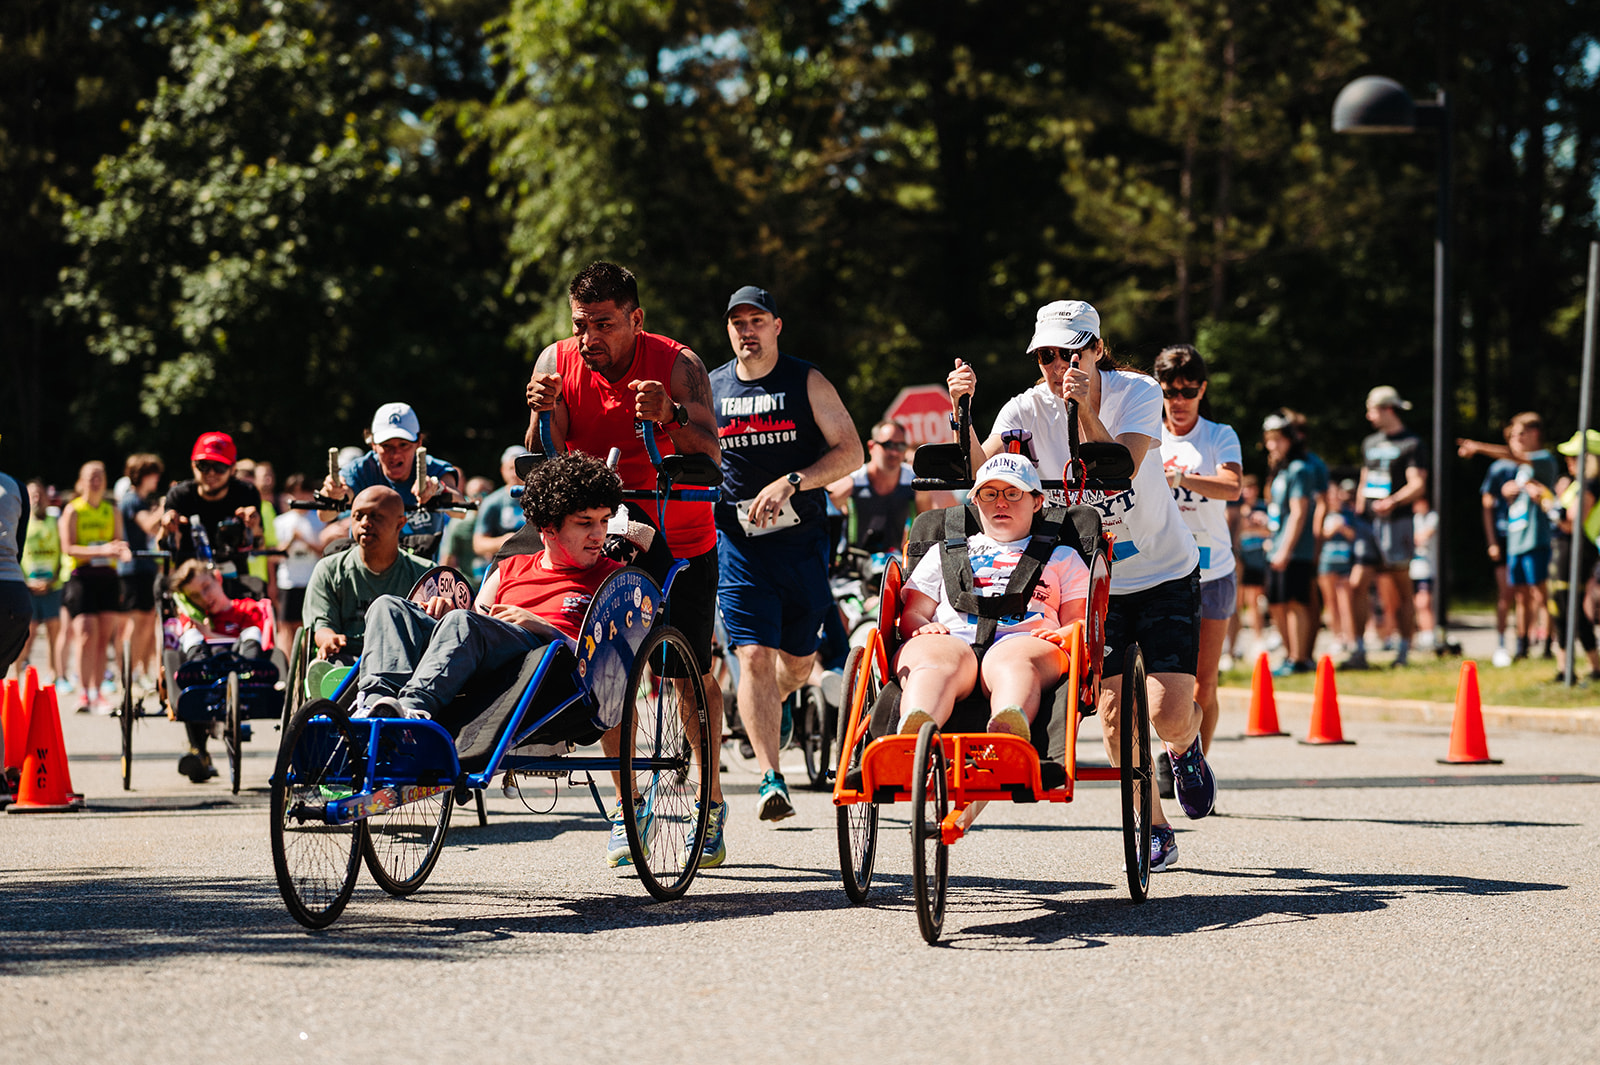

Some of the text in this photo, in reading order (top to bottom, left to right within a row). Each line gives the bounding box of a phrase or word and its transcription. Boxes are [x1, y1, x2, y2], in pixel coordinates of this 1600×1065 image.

[721, 392, 786, 416] TEAM HOYT
[751, 430, 797, 446] BOSTON
[985, 457, 1017, 474] MAINE
[440, 577, 454, 593] 50K
[459, 585, 468, 604] 50
